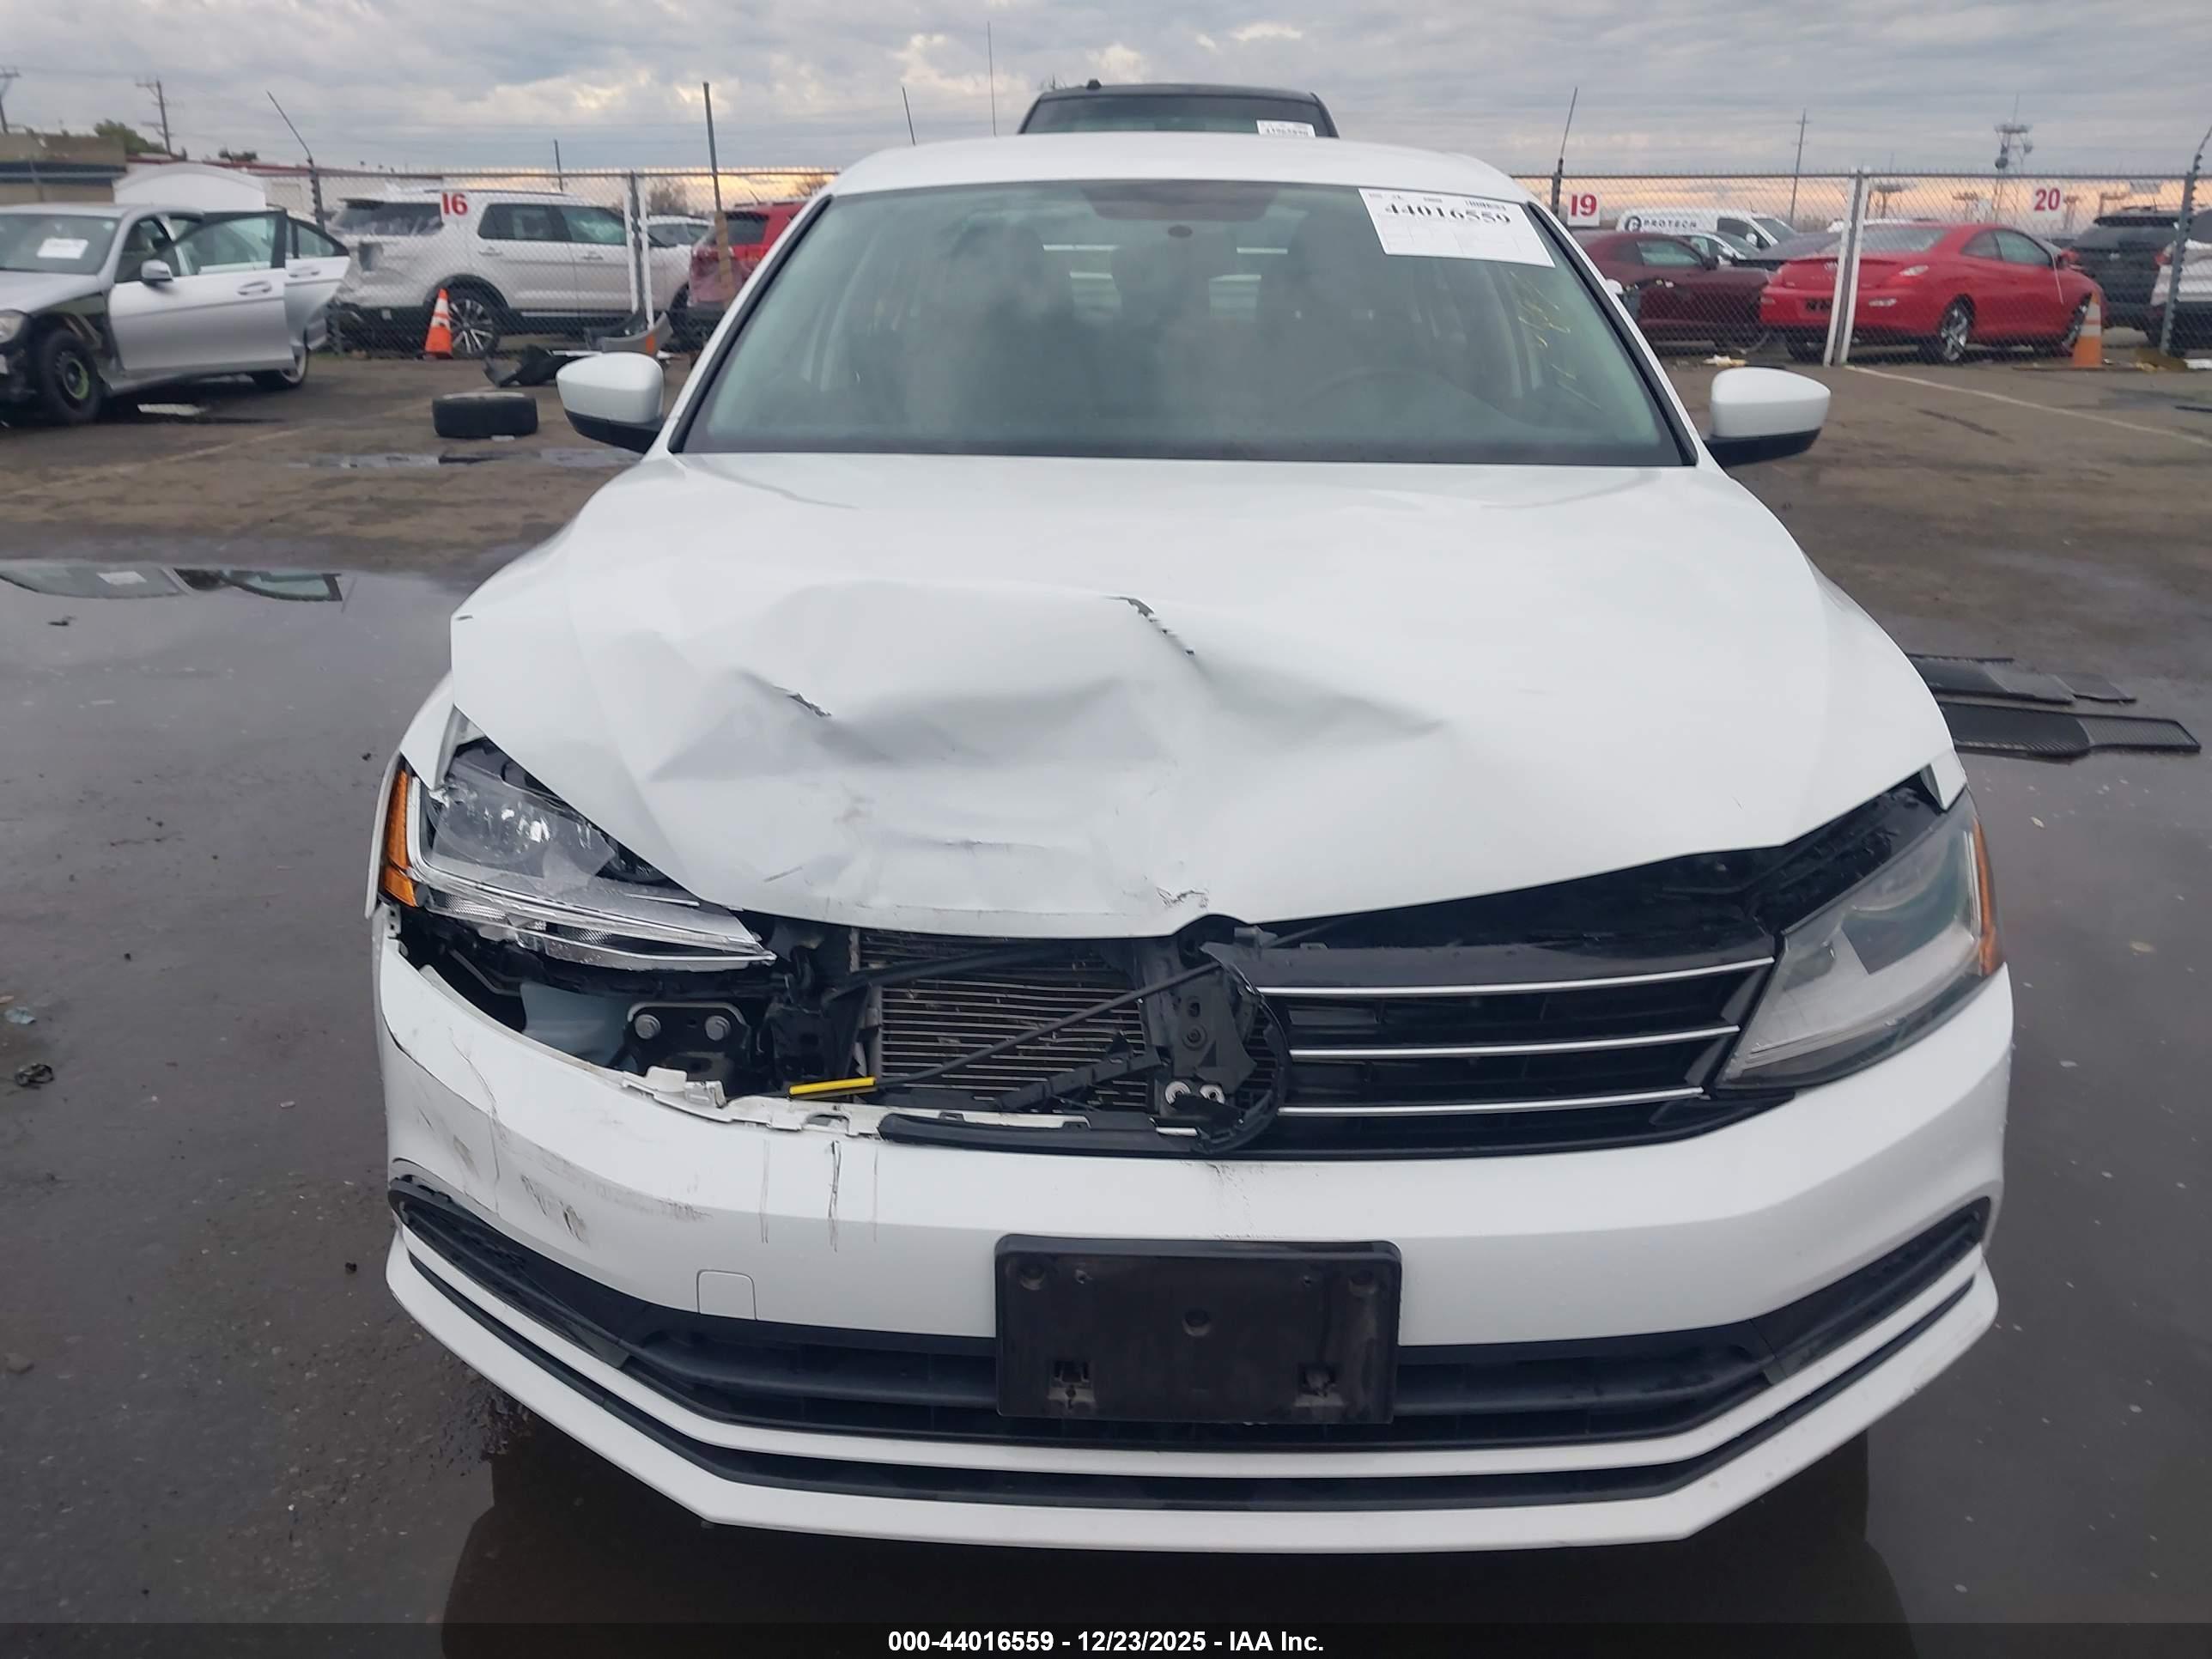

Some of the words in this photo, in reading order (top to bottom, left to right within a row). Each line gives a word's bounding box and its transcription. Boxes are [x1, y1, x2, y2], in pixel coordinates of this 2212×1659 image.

[442, 191, 468, 216] 16
[1571, 194, 1597, 216] 19
[2033, 188, 2061, 211] 20
[1384, 203, 1511, 224] 44016559
